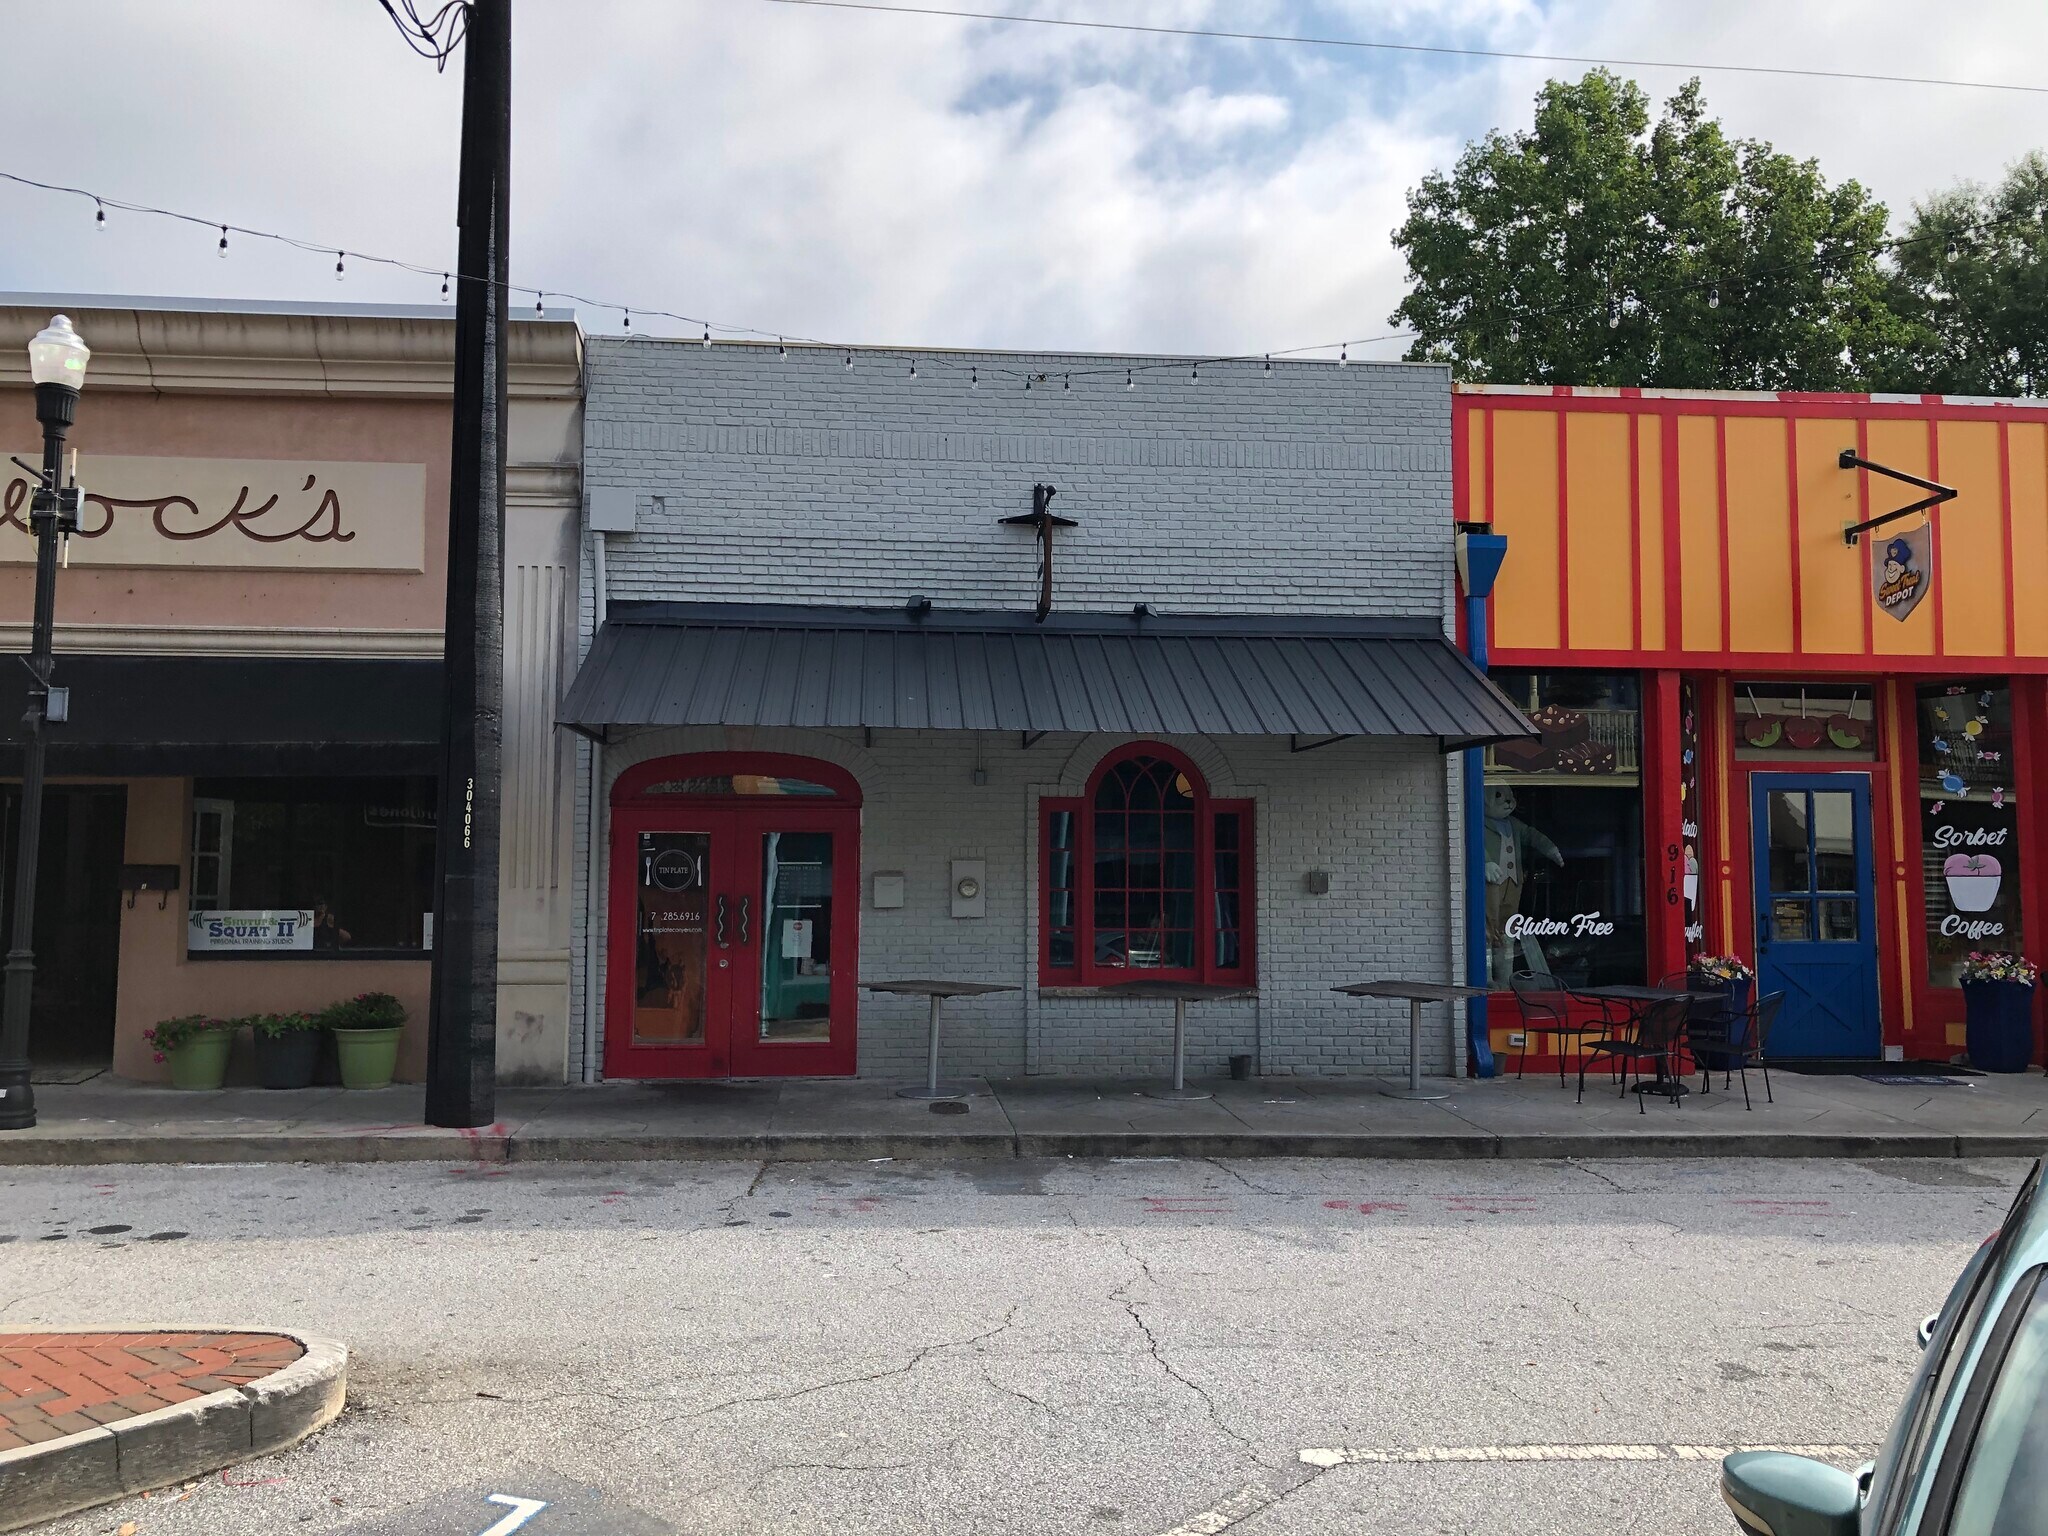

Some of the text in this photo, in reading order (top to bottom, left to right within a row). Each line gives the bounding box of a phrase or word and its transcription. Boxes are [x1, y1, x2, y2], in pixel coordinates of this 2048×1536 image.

[1885, 585, 1914, 606] DEPOT
[463, 777, 474, 849] 304066
[1682, 818, 1698, 838] lato
[1932, 825, 2008, 849] Sorbet
[1667, 844, 1679, 906] 916
[209, 922, 295, 938] SQUAT II
[1504, 910, 1614, 940] Gluten Free
[1940, 914, 2005, 941] Coffee
